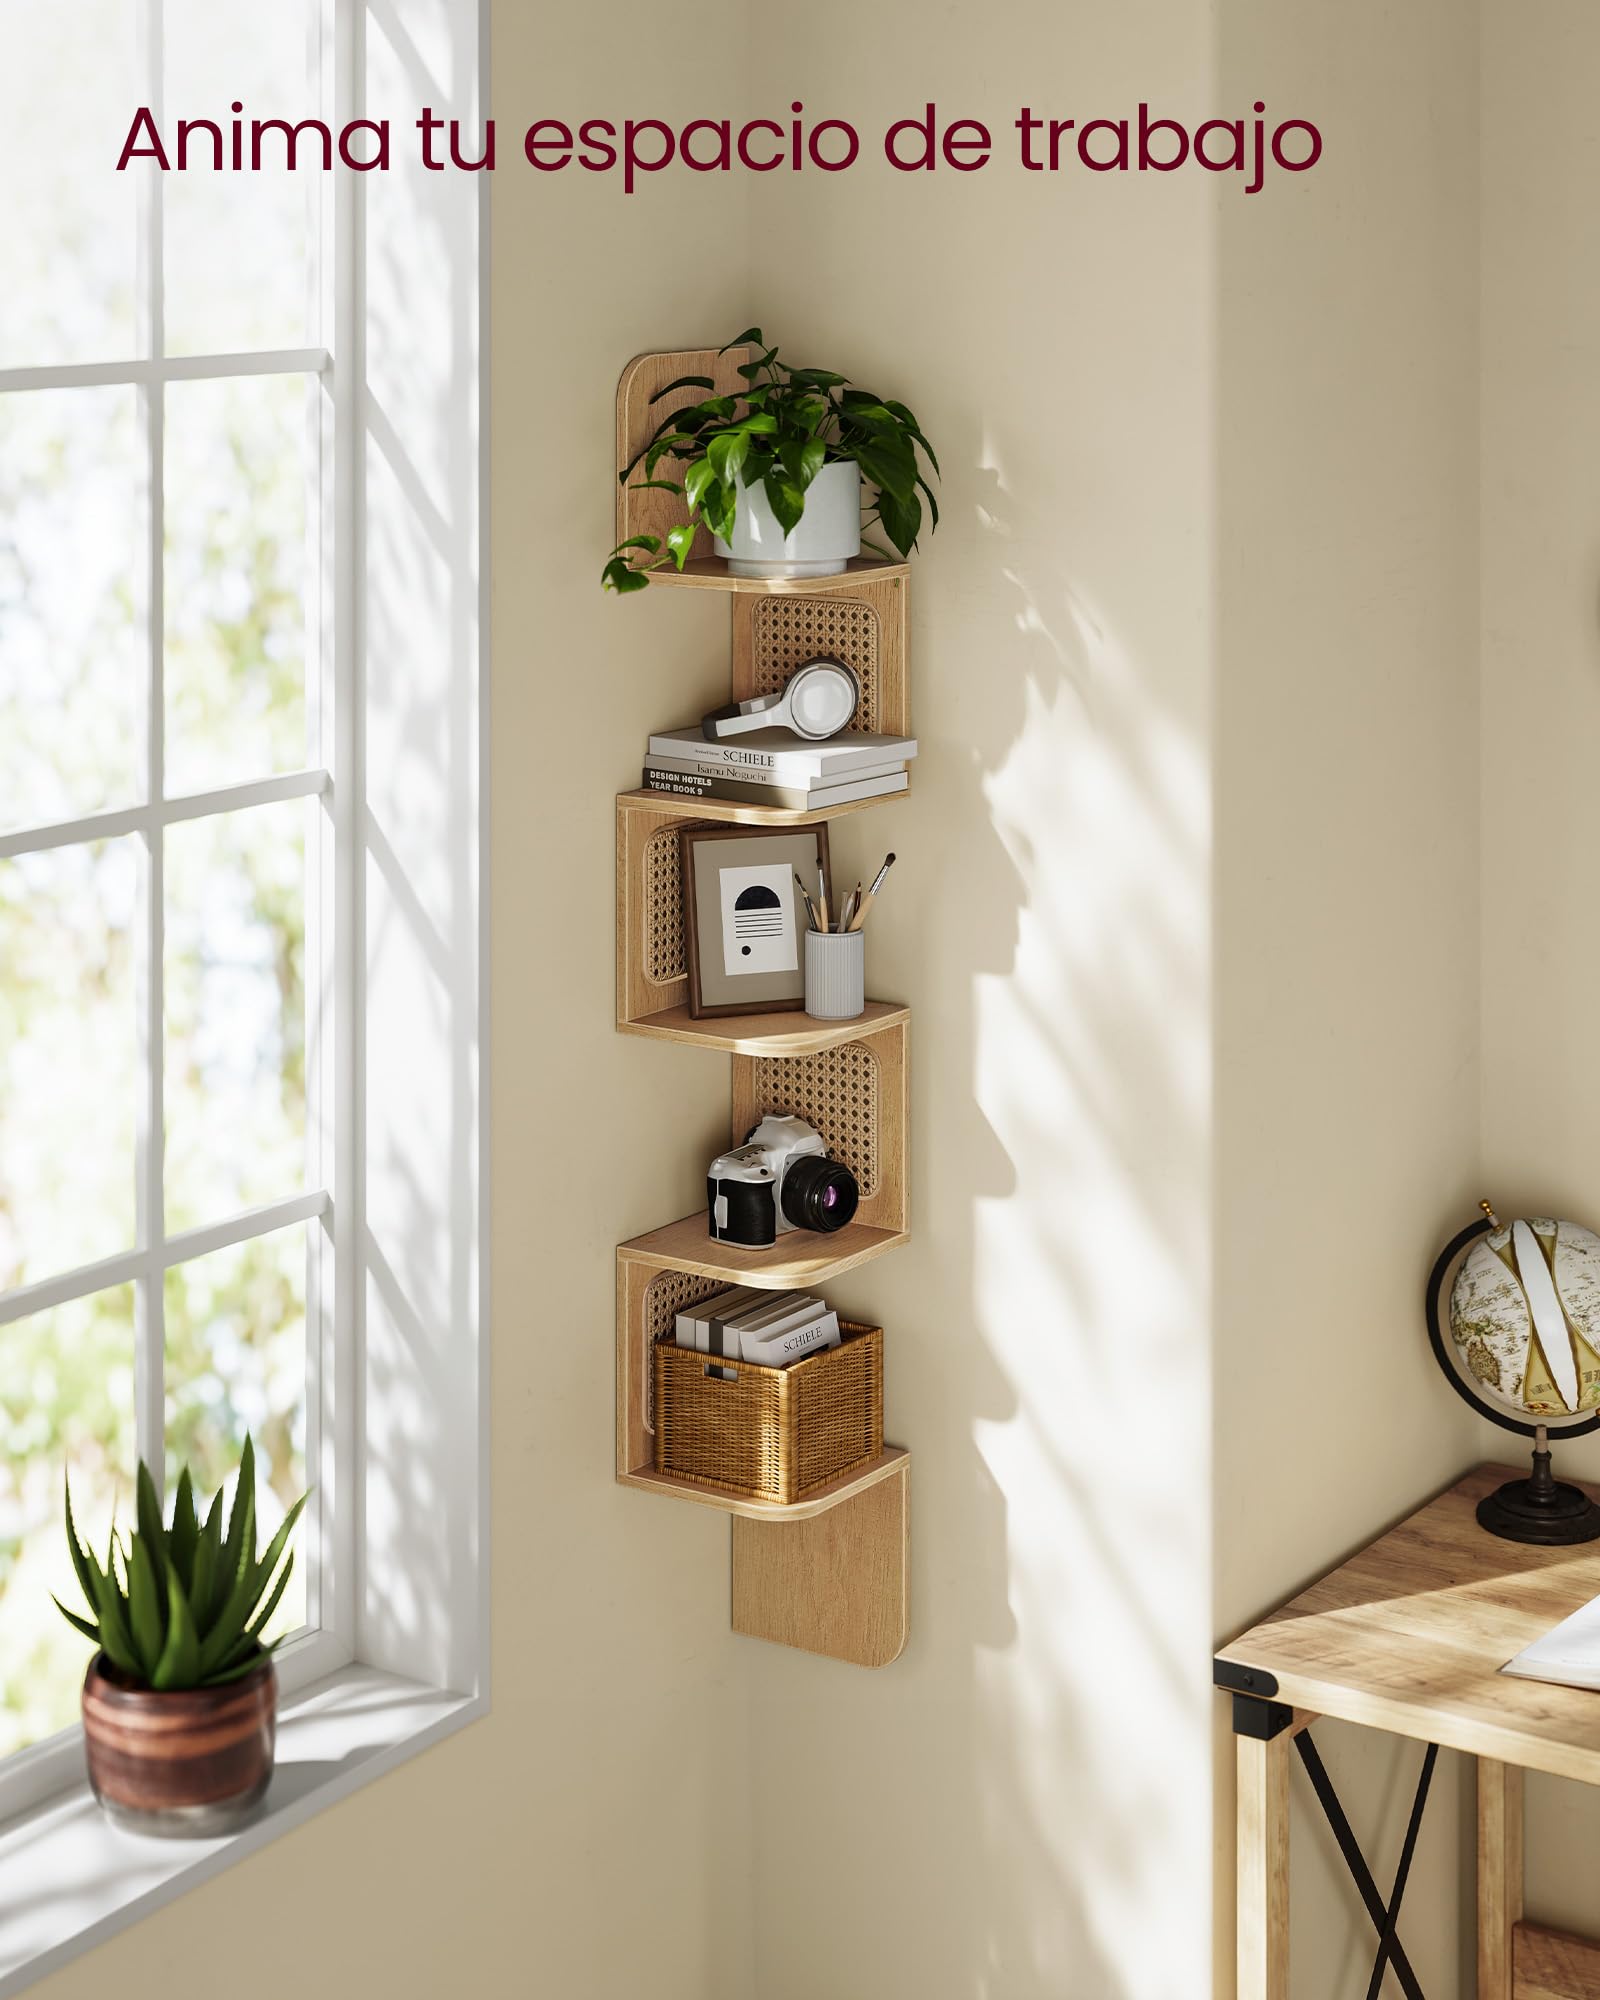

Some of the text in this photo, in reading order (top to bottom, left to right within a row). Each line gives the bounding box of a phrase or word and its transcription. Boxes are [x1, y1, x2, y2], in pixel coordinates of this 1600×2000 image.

[723, 750, 775, 767] SCHIELE
[650, 771, 712, 786] DESIGN HOTELS
[697, 763, 767, 782] Isamu Noguchi
[649, 781, 703, 795] YEAR BOOK 9
[783, 1326, 823, 1353] SCHIELE
